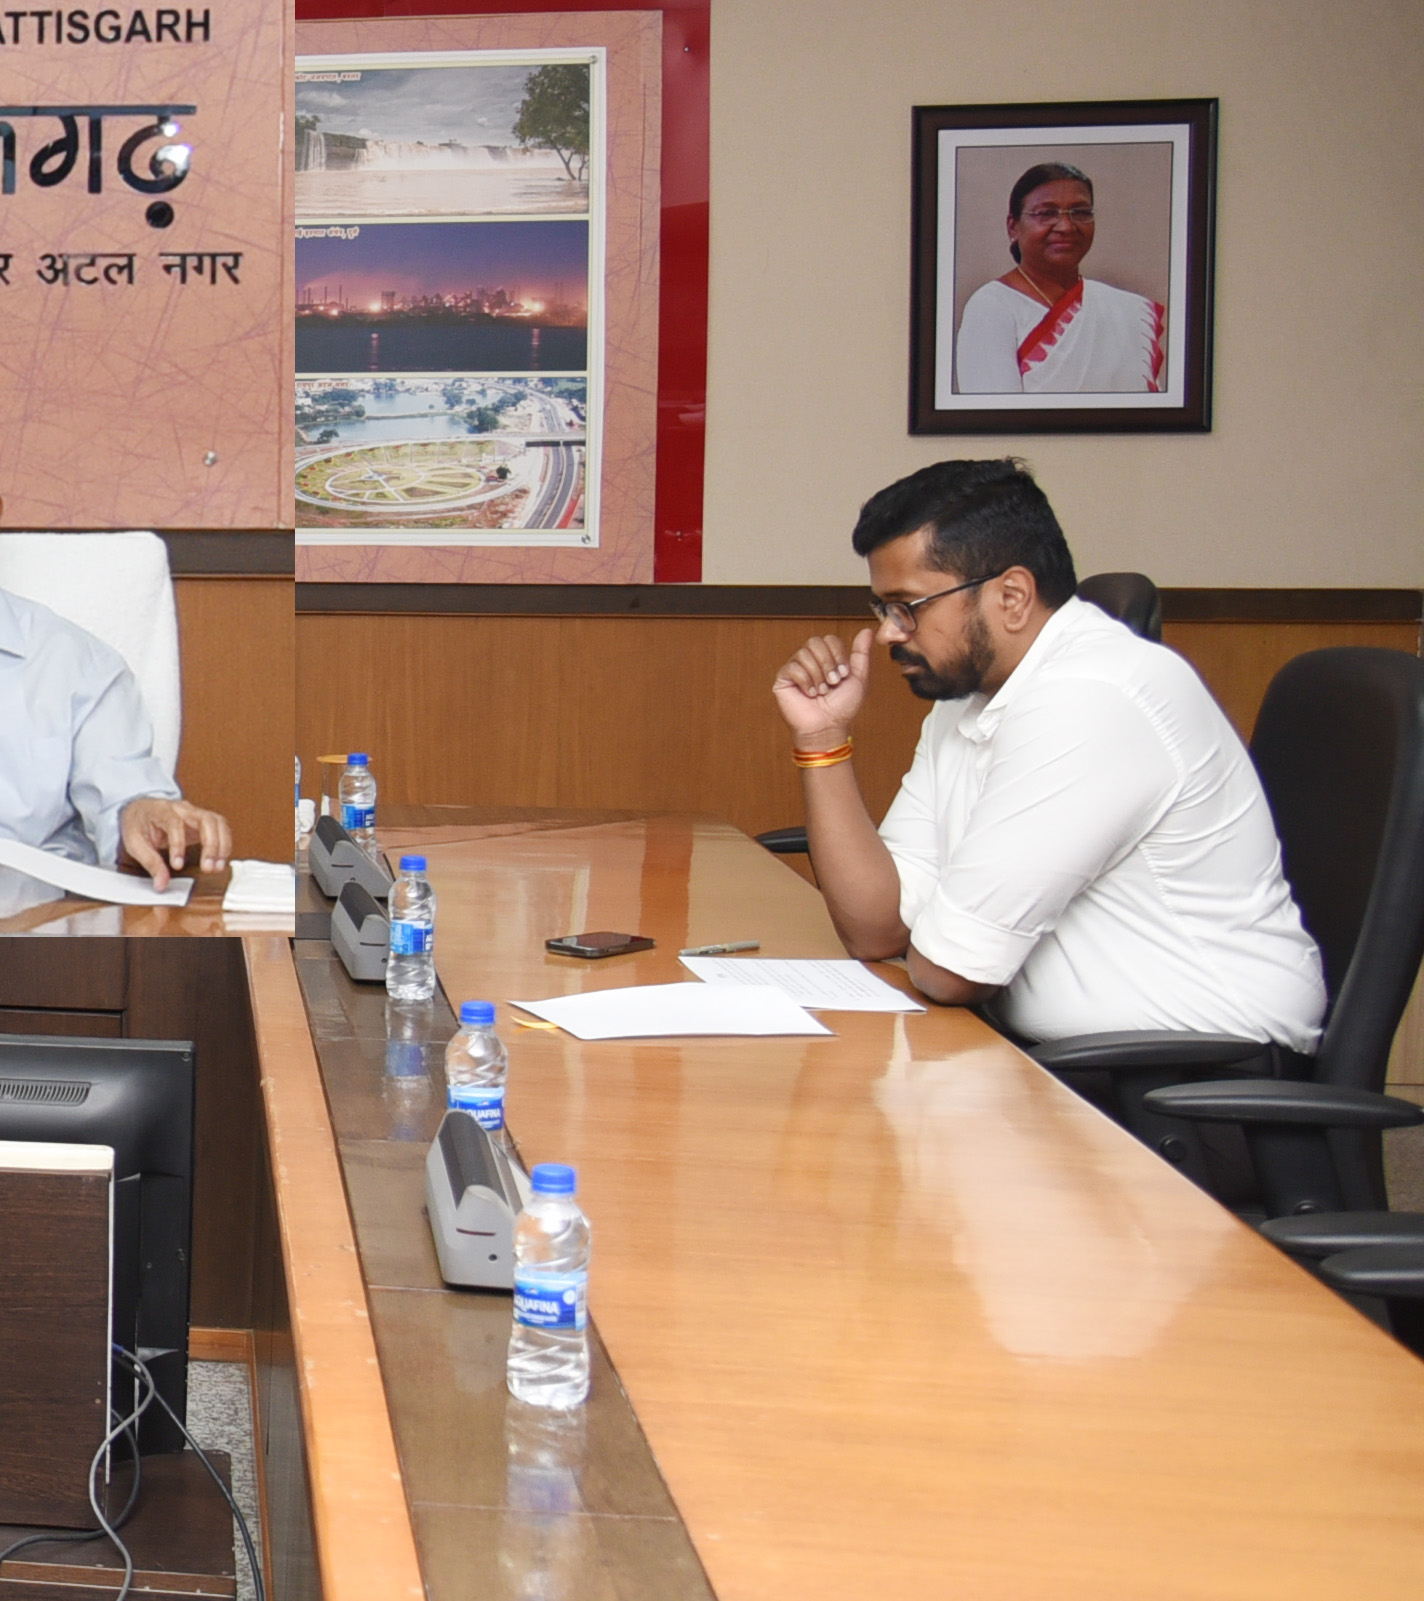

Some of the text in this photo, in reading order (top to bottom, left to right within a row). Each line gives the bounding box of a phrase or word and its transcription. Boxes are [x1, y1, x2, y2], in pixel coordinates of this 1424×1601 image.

[36, 253, 137, 286] अटल
[159, 252, 244, 286] नगर
[465, 1107, 501, 1121] QUAFINA
